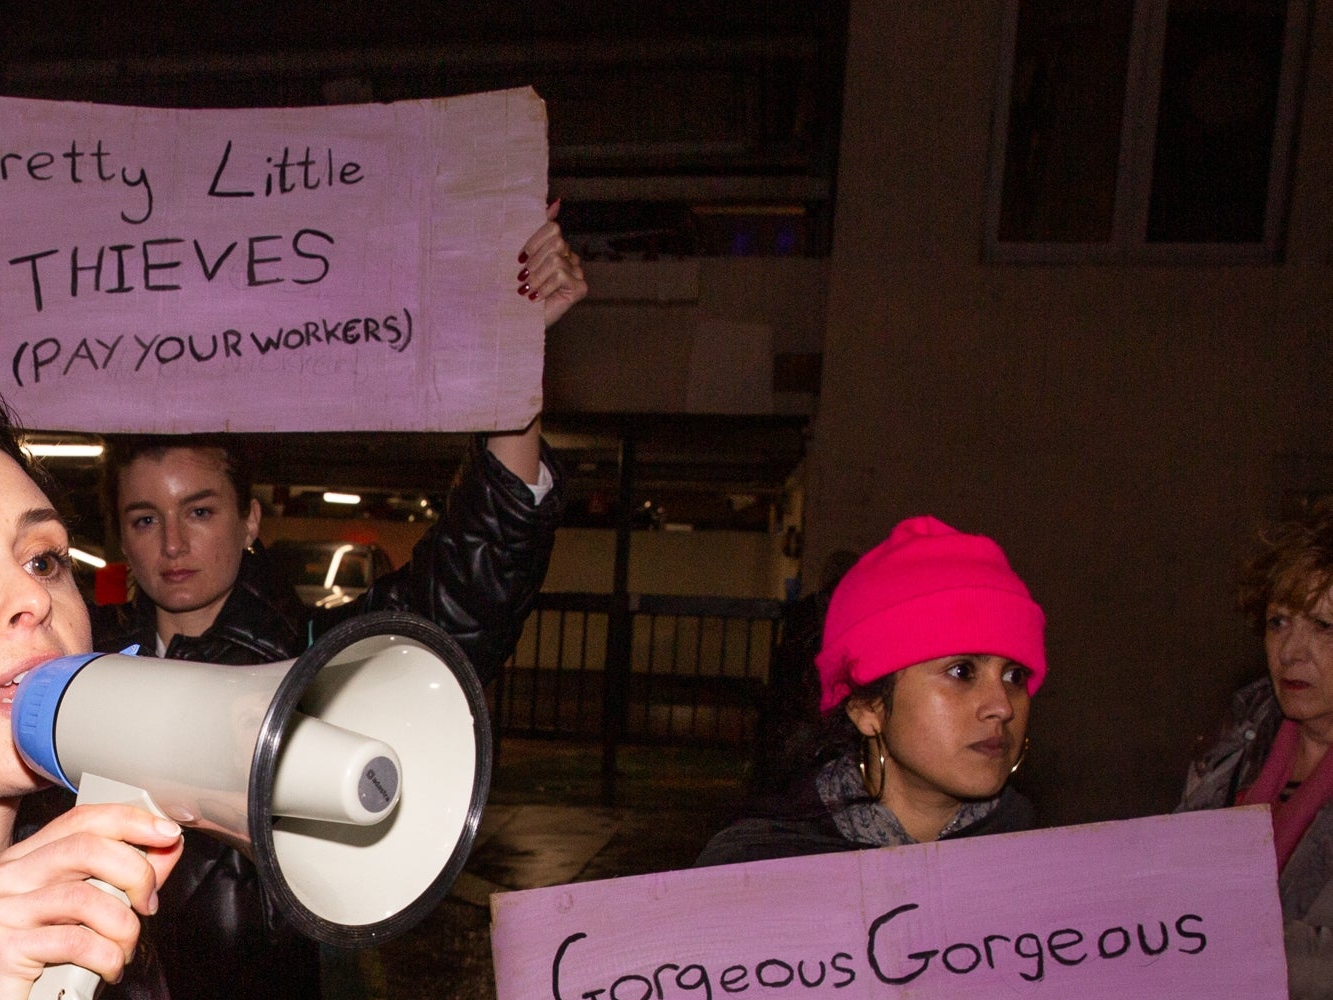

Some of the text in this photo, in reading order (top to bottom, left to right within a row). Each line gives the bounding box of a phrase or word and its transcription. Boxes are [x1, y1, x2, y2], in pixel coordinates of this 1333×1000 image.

[208, 139, 364, 198] Little
[9, 228, 335, 312] THIEVES
[12, 307, 412, 388] (PAY YOUR WORKERS)
[866, 903, 1208, 986] Gorgeous
